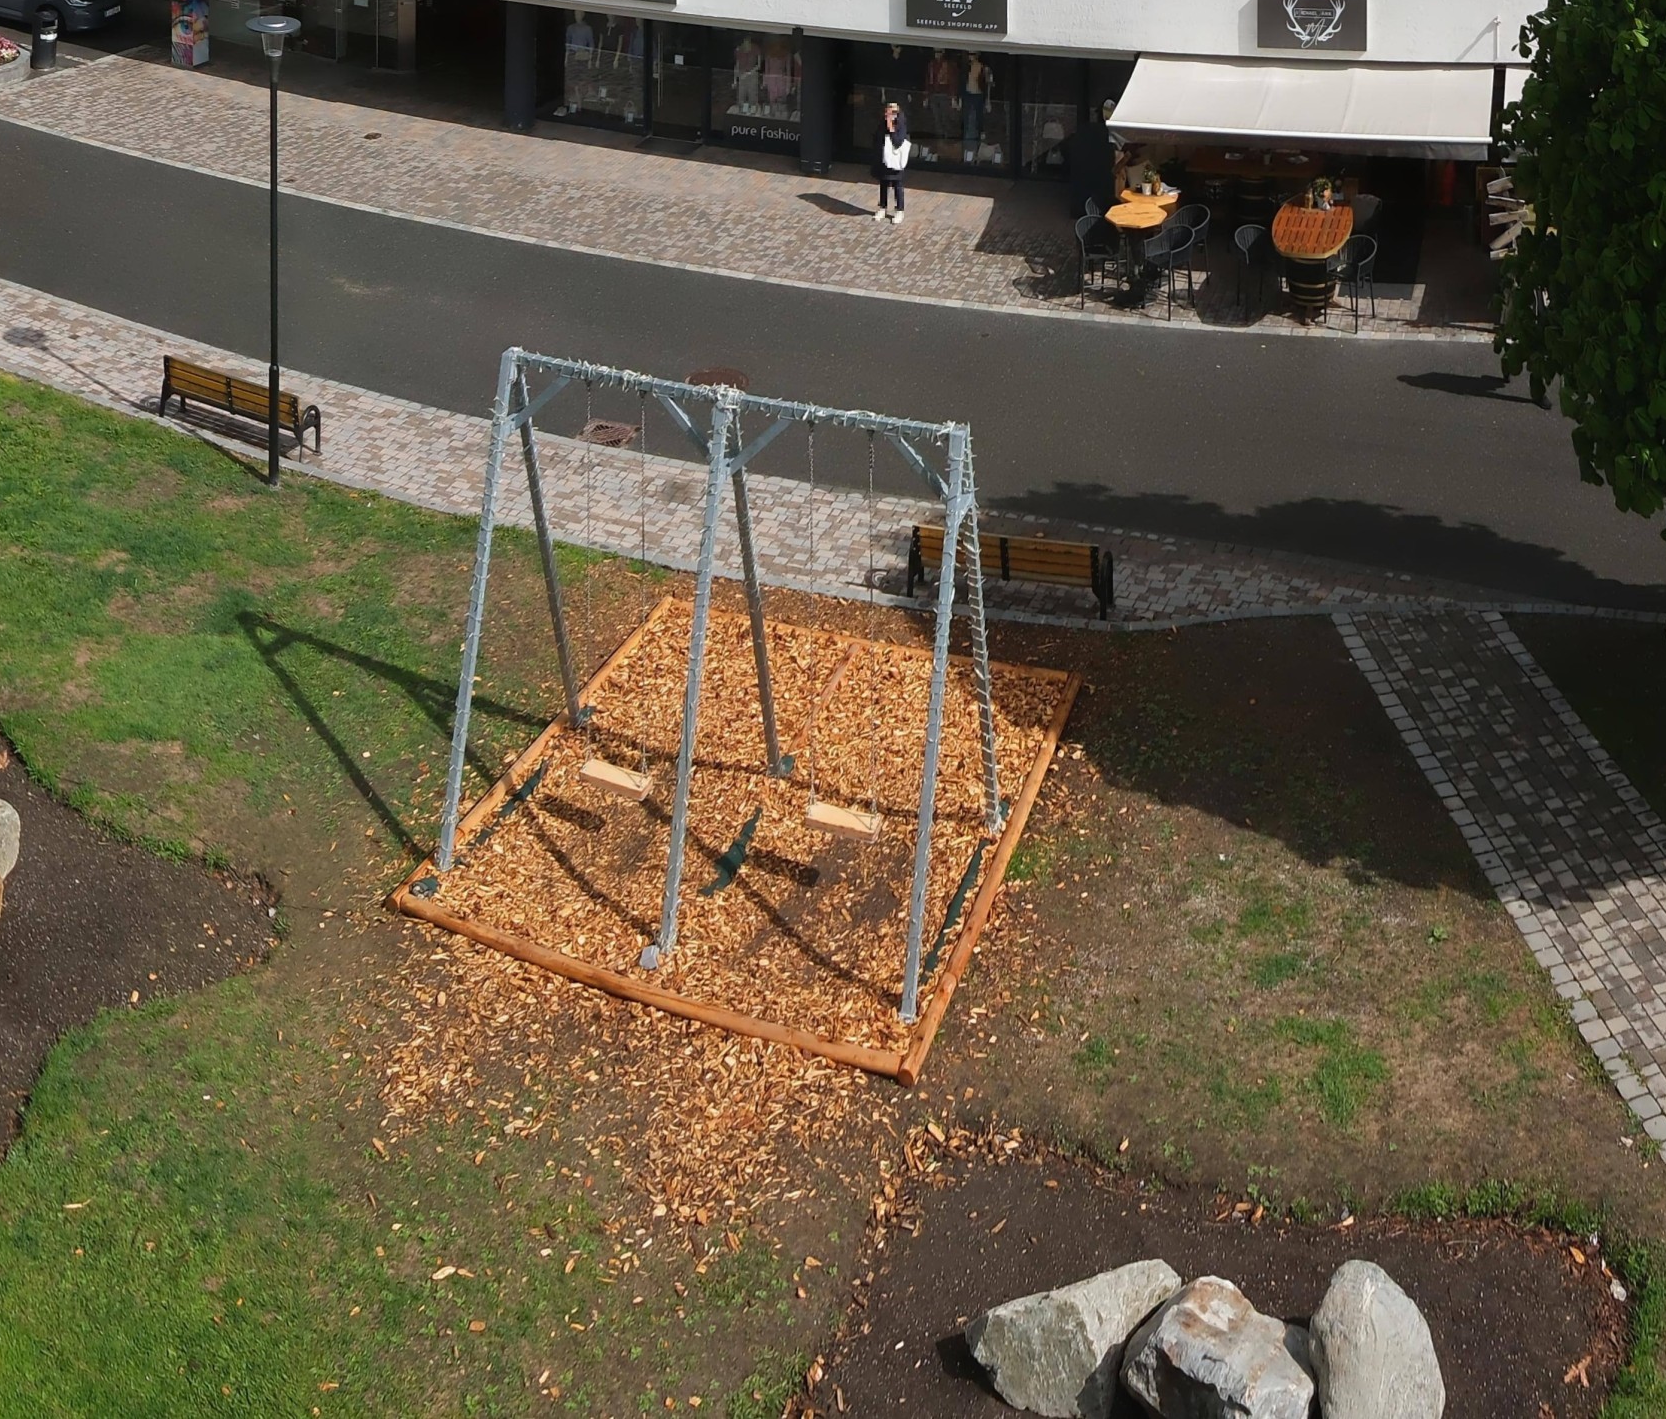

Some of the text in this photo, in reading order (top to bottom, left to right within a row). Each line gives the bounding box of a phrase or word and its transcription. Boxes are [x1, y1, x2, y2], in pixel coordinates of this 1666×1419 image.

[916, 18, 945, 27] SEEFELD
[947, 21, 982, 29] SHOPPING
[731, 125, 757, 136] pure
